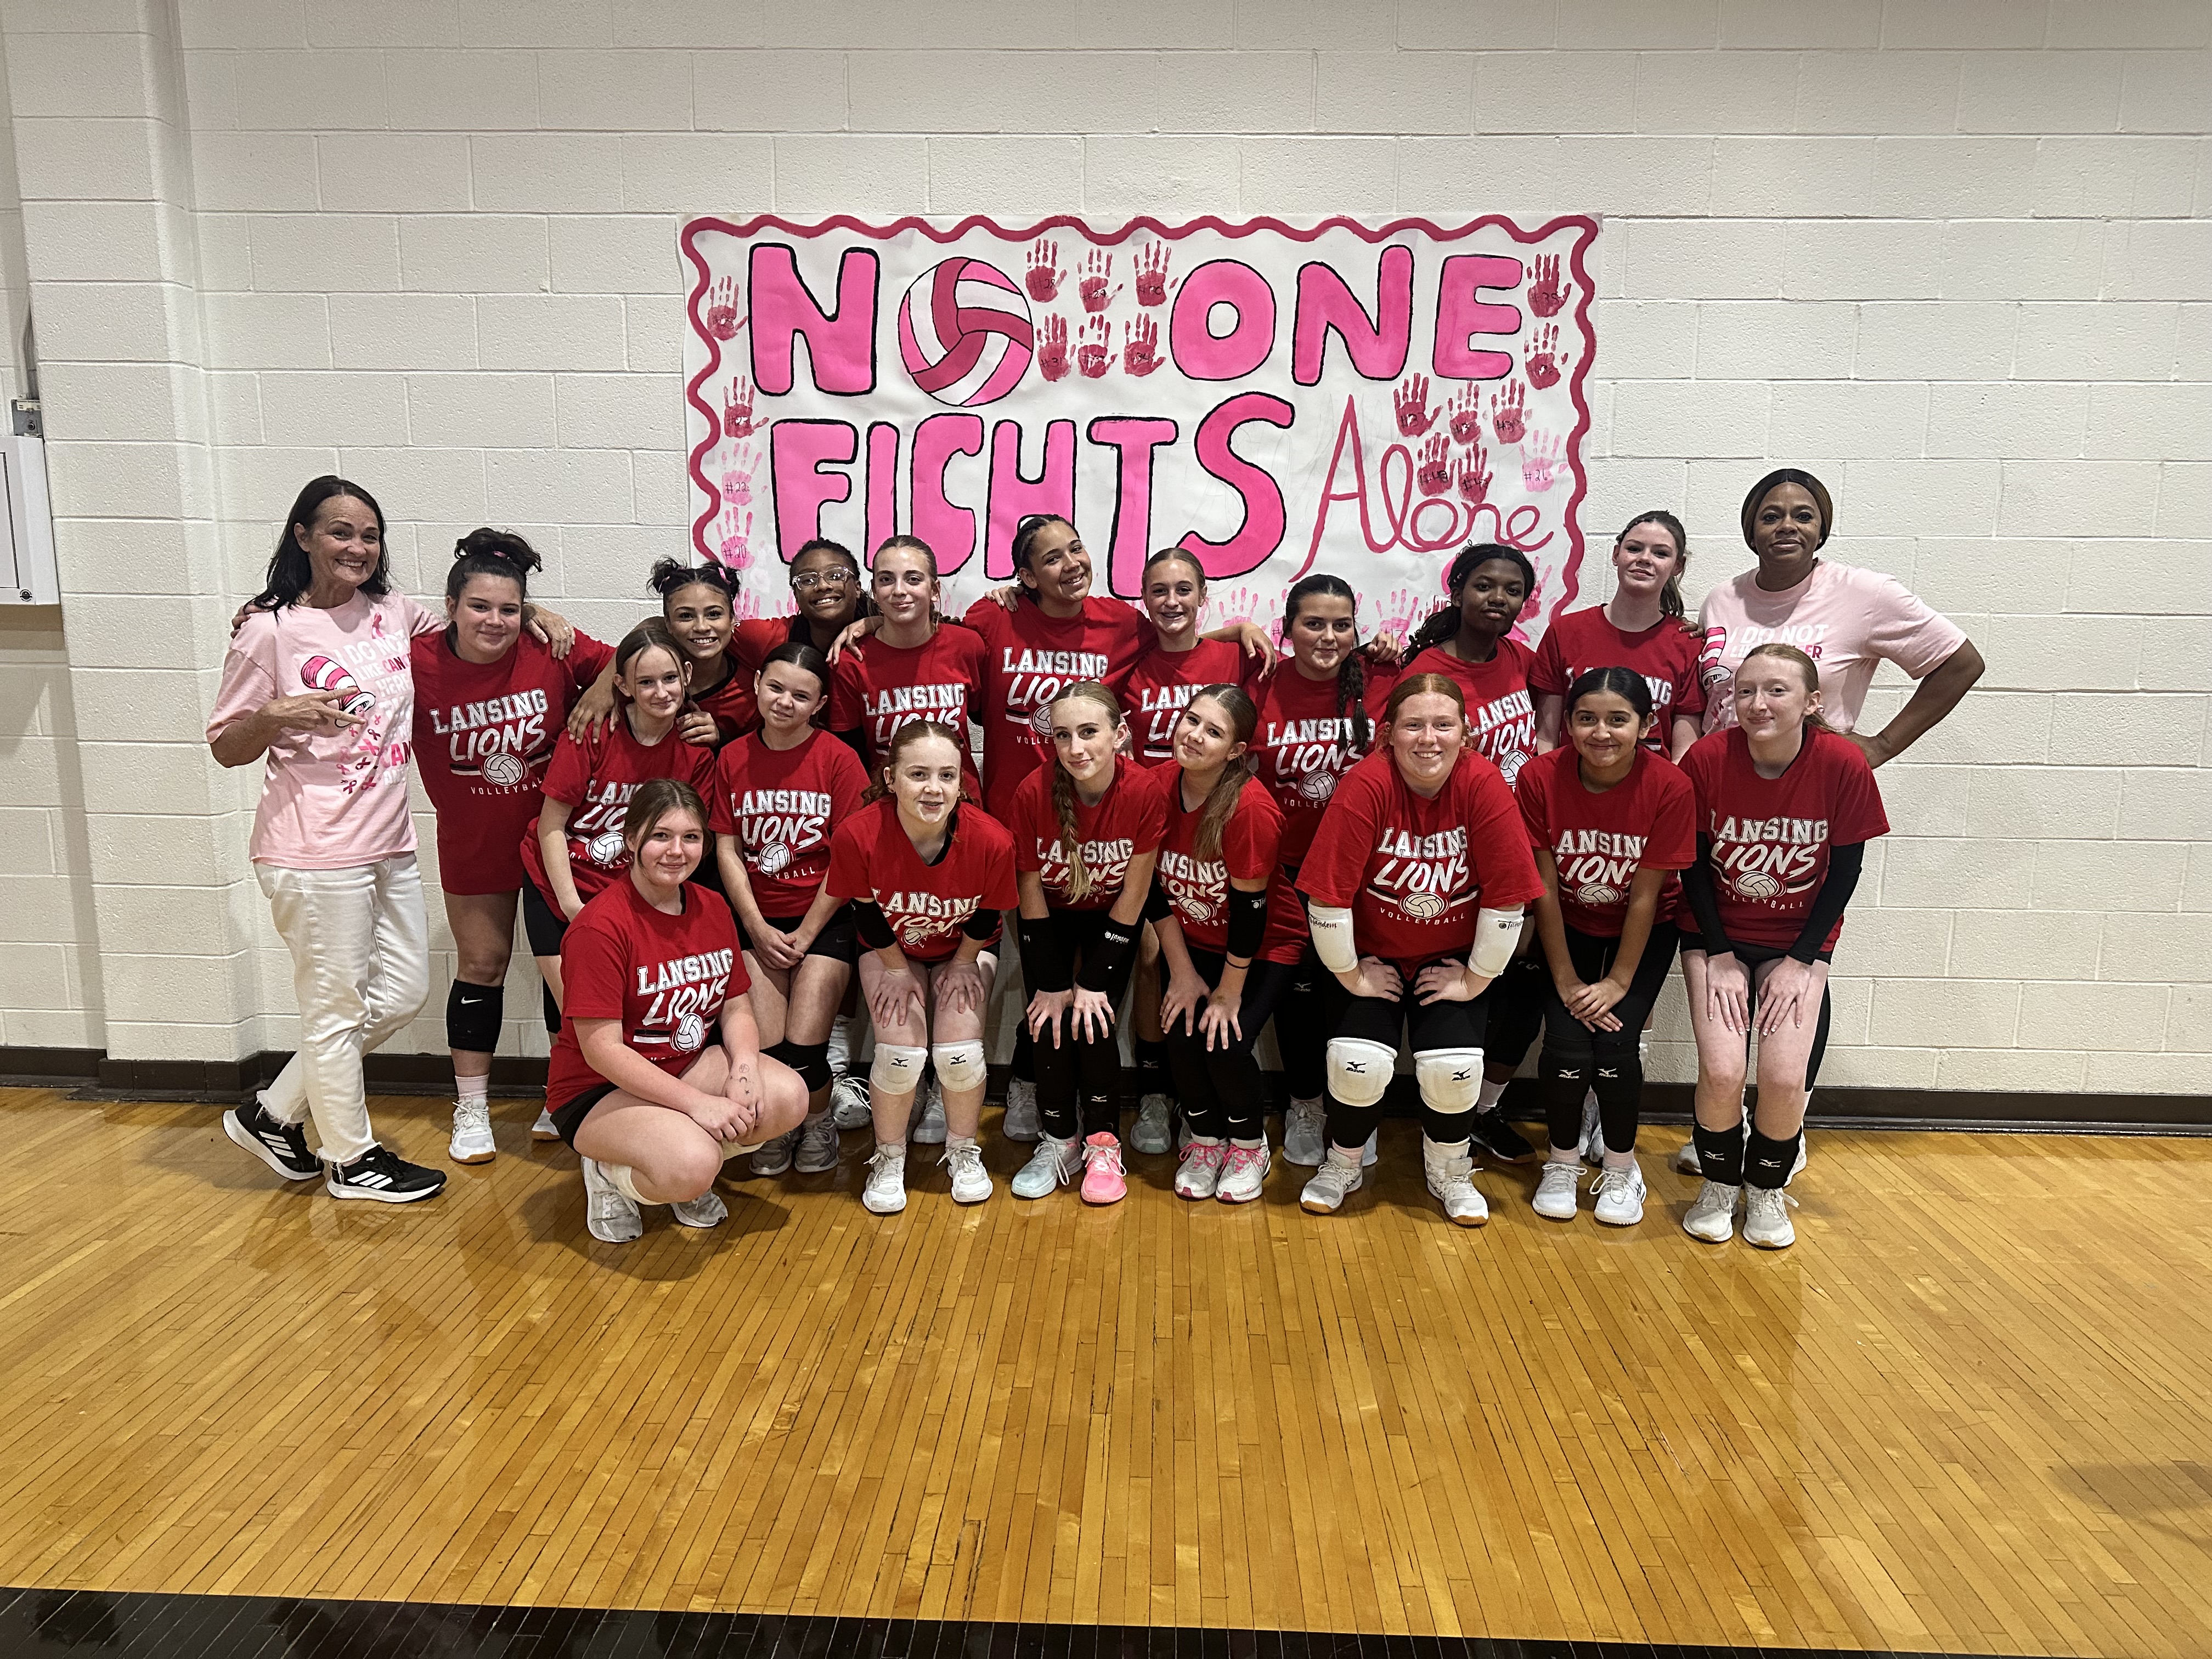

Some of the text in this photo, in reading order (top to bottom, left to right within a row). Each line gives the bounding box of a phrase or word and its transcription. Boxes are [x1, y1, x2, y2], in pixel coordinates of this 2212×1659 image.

[1170, 244, 1523, 386] ONE
[725, 482, 747, 494] #22
[1523, 469, 1548, 481] #26
[771, 392, 1554, 599] FIGHTS Alone
[723, 544, 747, 560] #20
[1740, 626, 1777, 644] DO
[1779, 624, 1829, 644] NOT
[345, 640, 376, 662] DO
[1002, 647, 1108, 679] LANSING
[354, 662, 383, 681] LIKE
[429, 688, 549, 735] LANSING
[861, 682, 966, 716] LANSING
[1465, 689, 1533, 737] LANSIN
[449, 713, 546, 761] LIONS
[1017, 736, 1057, 745] VOLLE
[1276, 742, 1365, 776] LIONS
[470, 772, 545, 795] VOLLEYBAL
[573, 804, 629, 832] LIO
[731, 789, 832, 819] LANSING
[1284, 797, 1327, 809] VOLLEY
[742, 814, 825, 851] LIONS
[768, 866, 816, 880] YBALL
[1159, 849, 1229, 884] NSING
[1373, 850, 1470, 898] LIONS
[1711, 839, 1820, 881] LIONS
[1159, 874, 1228, 904] IONS
[1379, 906, 1465, 926] VOLLEYBALL
[637, 947, 733, 996] LANSING
[642, 974, 730, 1026] LIONS
